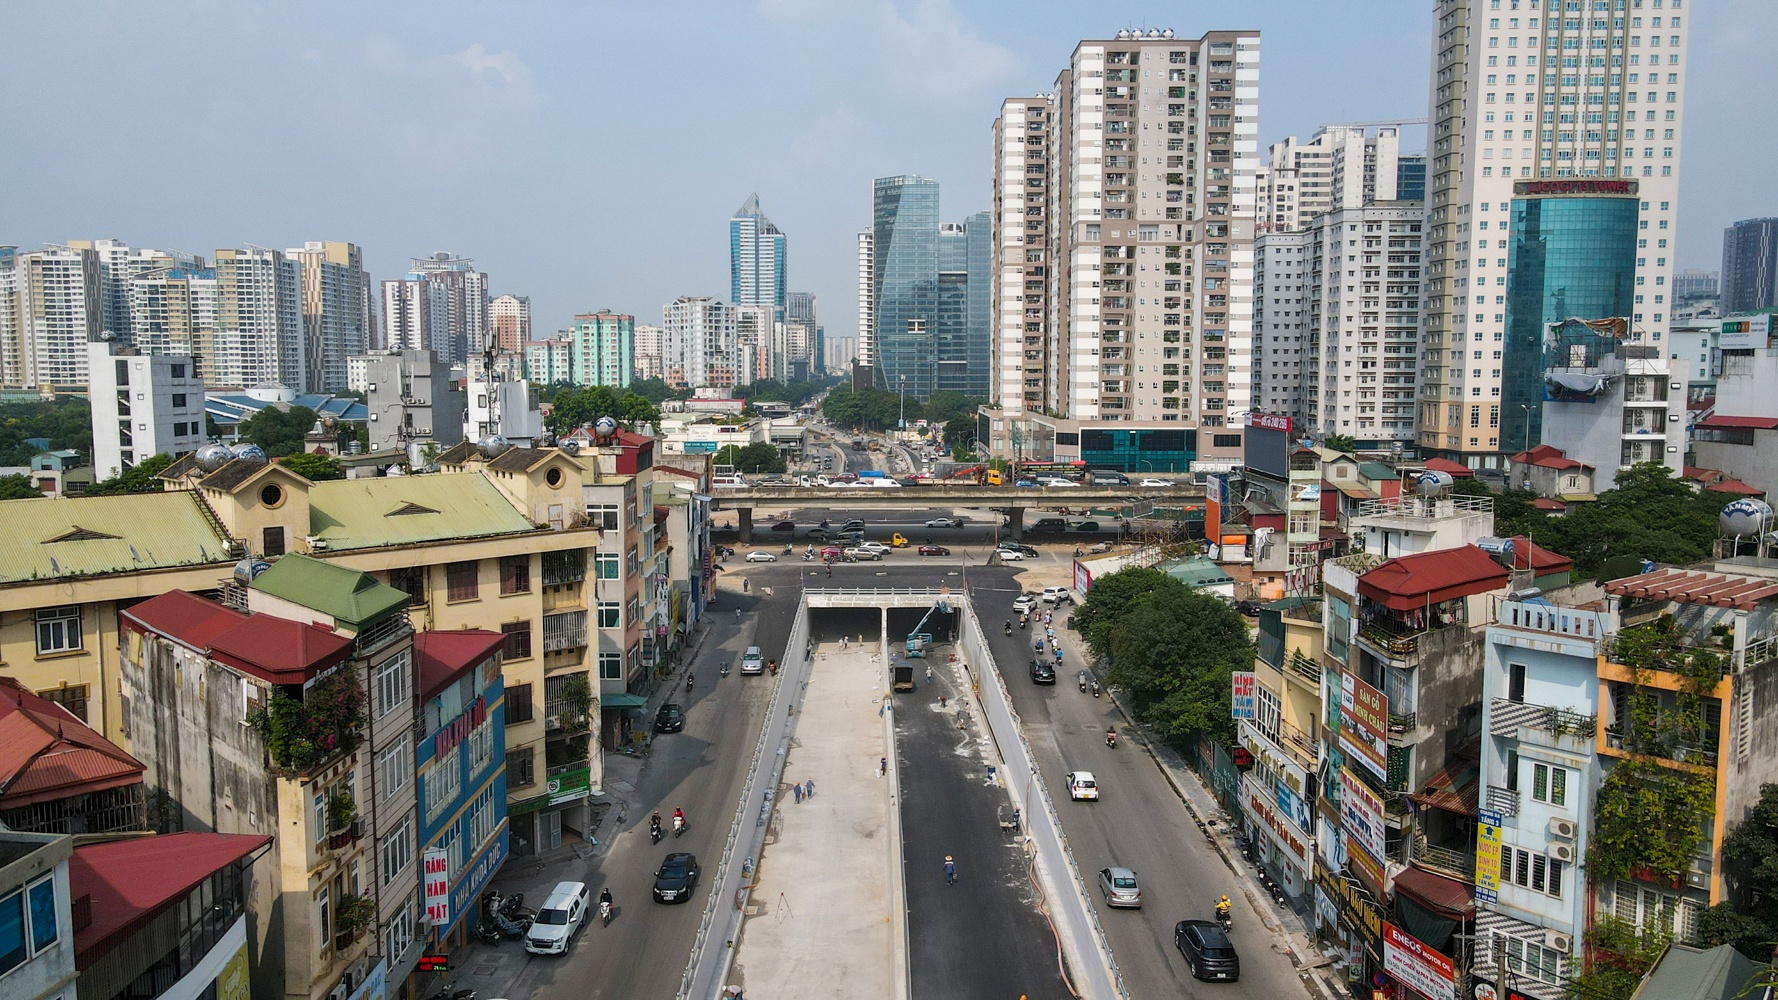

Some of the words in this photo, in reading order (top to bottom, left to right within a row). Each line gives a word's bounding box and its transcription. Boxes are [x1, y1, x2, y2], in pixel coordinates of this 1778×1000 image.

[1530, 181, 1572, 192] LICOGI
[1577, 181, 1588, 192] 13
[1593, 181, 1629, 192] TOWER
[1360, 688, 1370, 706] SÀN
[1372, 694, 1380, 712] GỖ
[1354, 703, 1368, 722] MINH
[436, 726, 452, 764] NHA
[452, 712, 472, 747] KHOA
[426, 856, 446, 875] RĂNG
[427, 879, 446, 897] HÀM
[454, 881, 470, 914] NHA
[470, 861, 488, 894] KHOA
[488, 842, 500, 874] ĐỨC
[428, 902, 447, 924] MẶT
[1392, 930, 1422, 954] ENEOS
[1422, 950, 1442, 966] MOTOR
[1442, 962, 1451, 972] OIL
[1430, 976, 1445, 990] MOTOR
